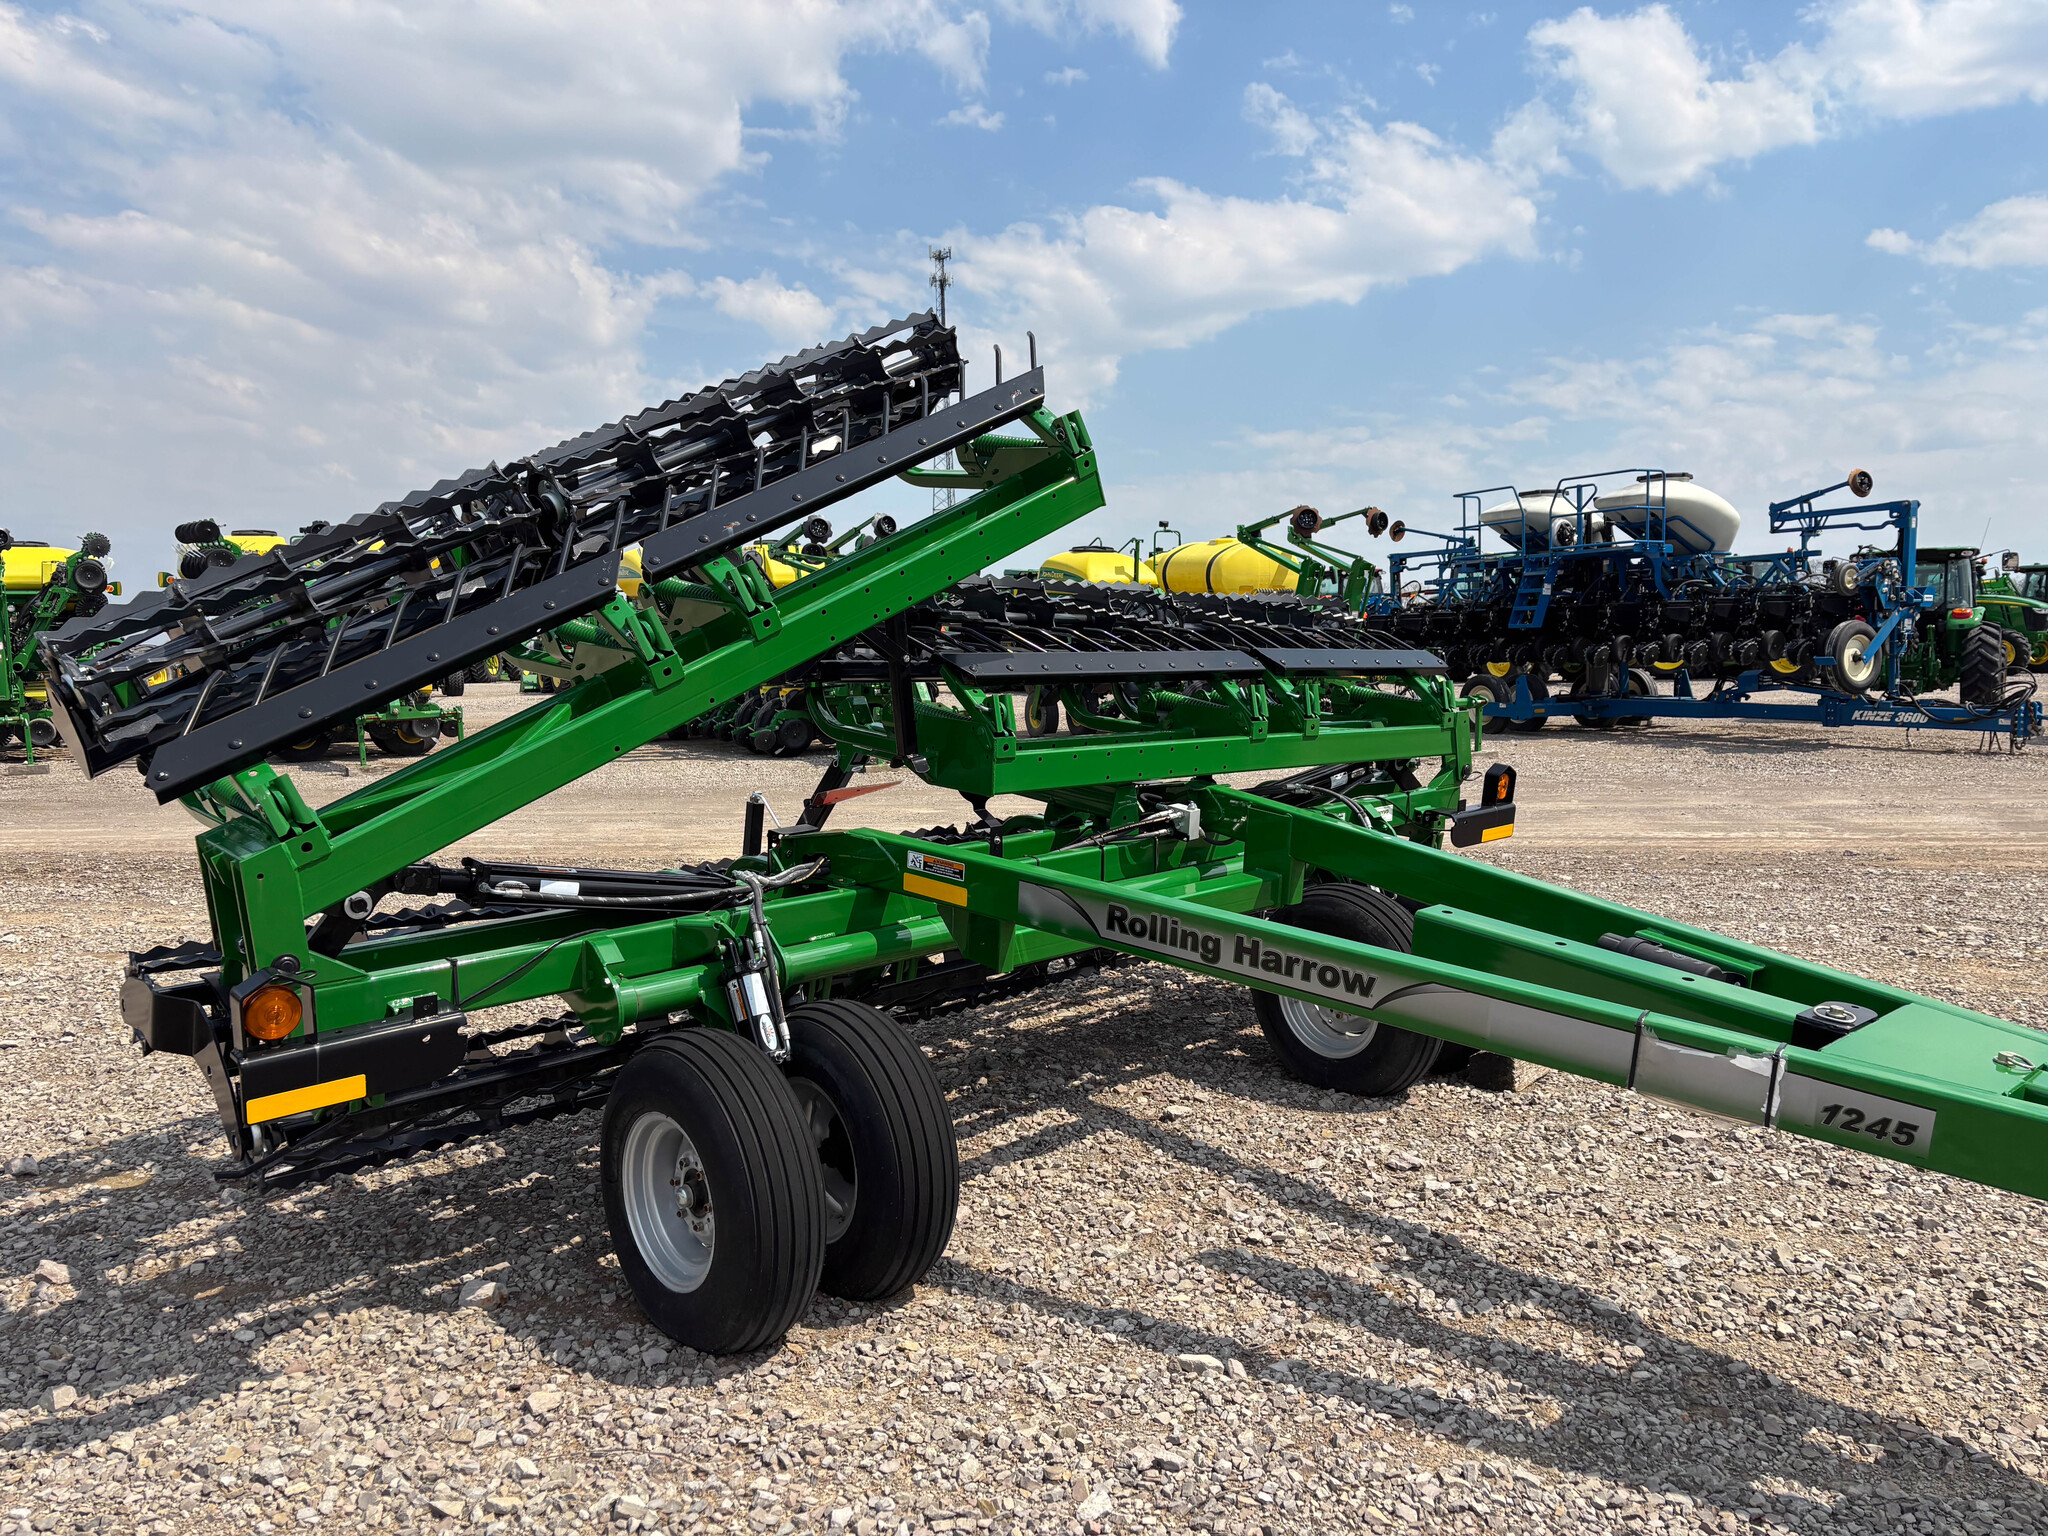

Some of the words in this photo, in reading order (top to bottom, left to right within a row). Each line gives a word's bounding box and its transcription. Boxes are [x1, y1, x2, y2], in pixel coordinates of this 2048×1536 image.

[1851, 710, 1895, 722] KINZE
[1894, 712, 1929, 723] 3600
[1106, 902, 1222, 965] Rolling
[1232, 933, 1378, 999] Harrow
[1820, 1103, 1920, 1147] 1245
